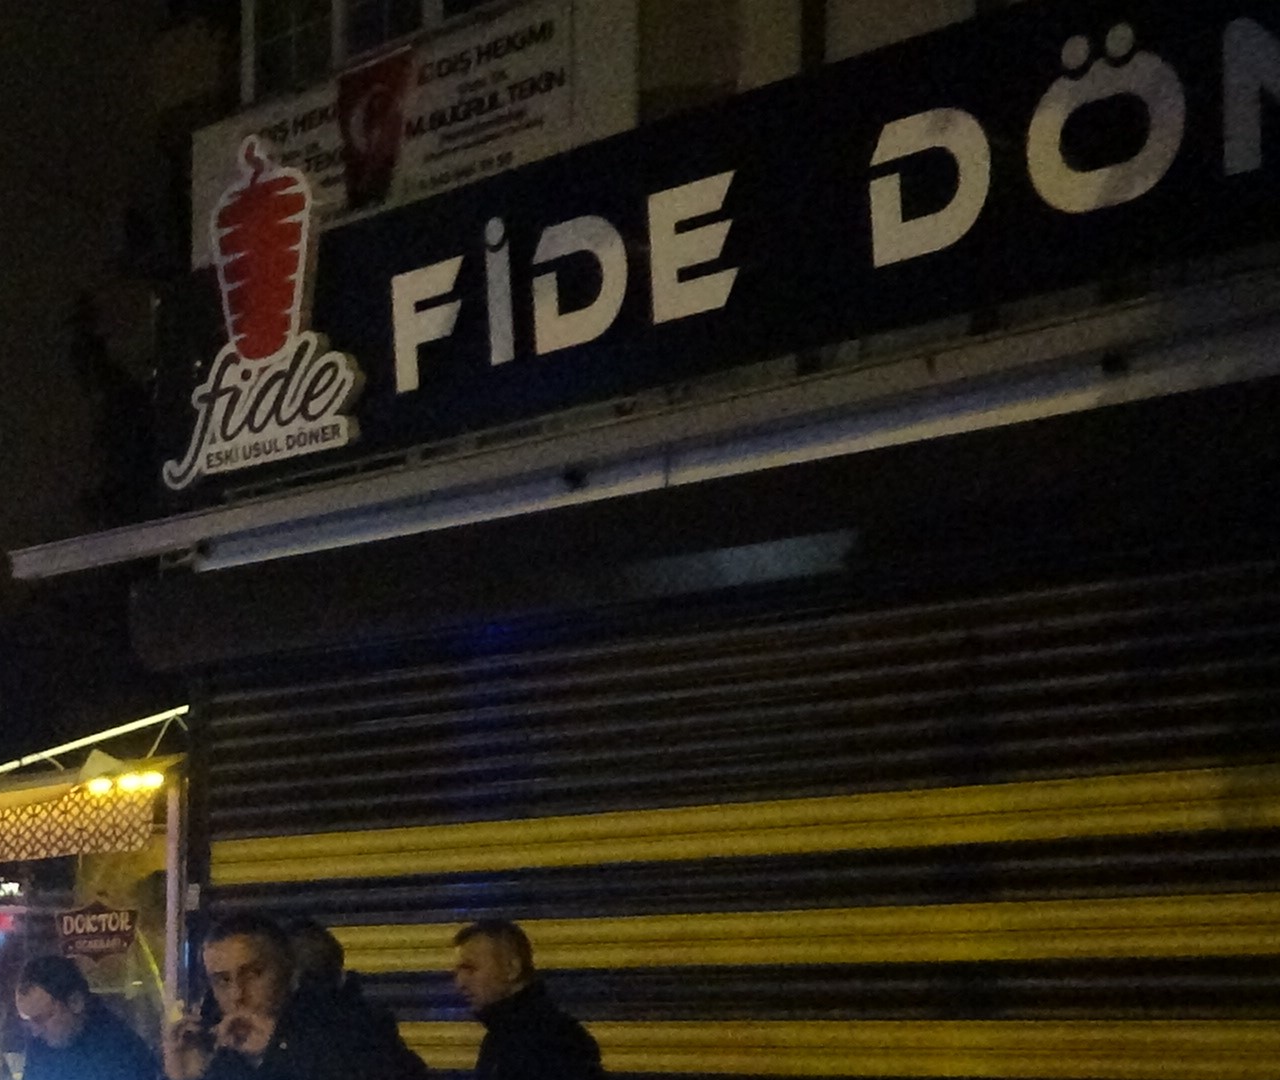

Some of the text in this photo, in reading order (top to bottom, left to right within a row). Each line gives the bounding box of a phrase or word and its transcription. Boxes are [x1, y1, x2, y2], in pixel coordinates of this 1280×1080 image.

[390, 169, 737, 394] FİDE
[167, 339, 347, 484] fide
[243, 442, 281, 461] USUL
[285, 422, 341, 451] DÖNER
[64, 911, 132, 936] DOKTOR
